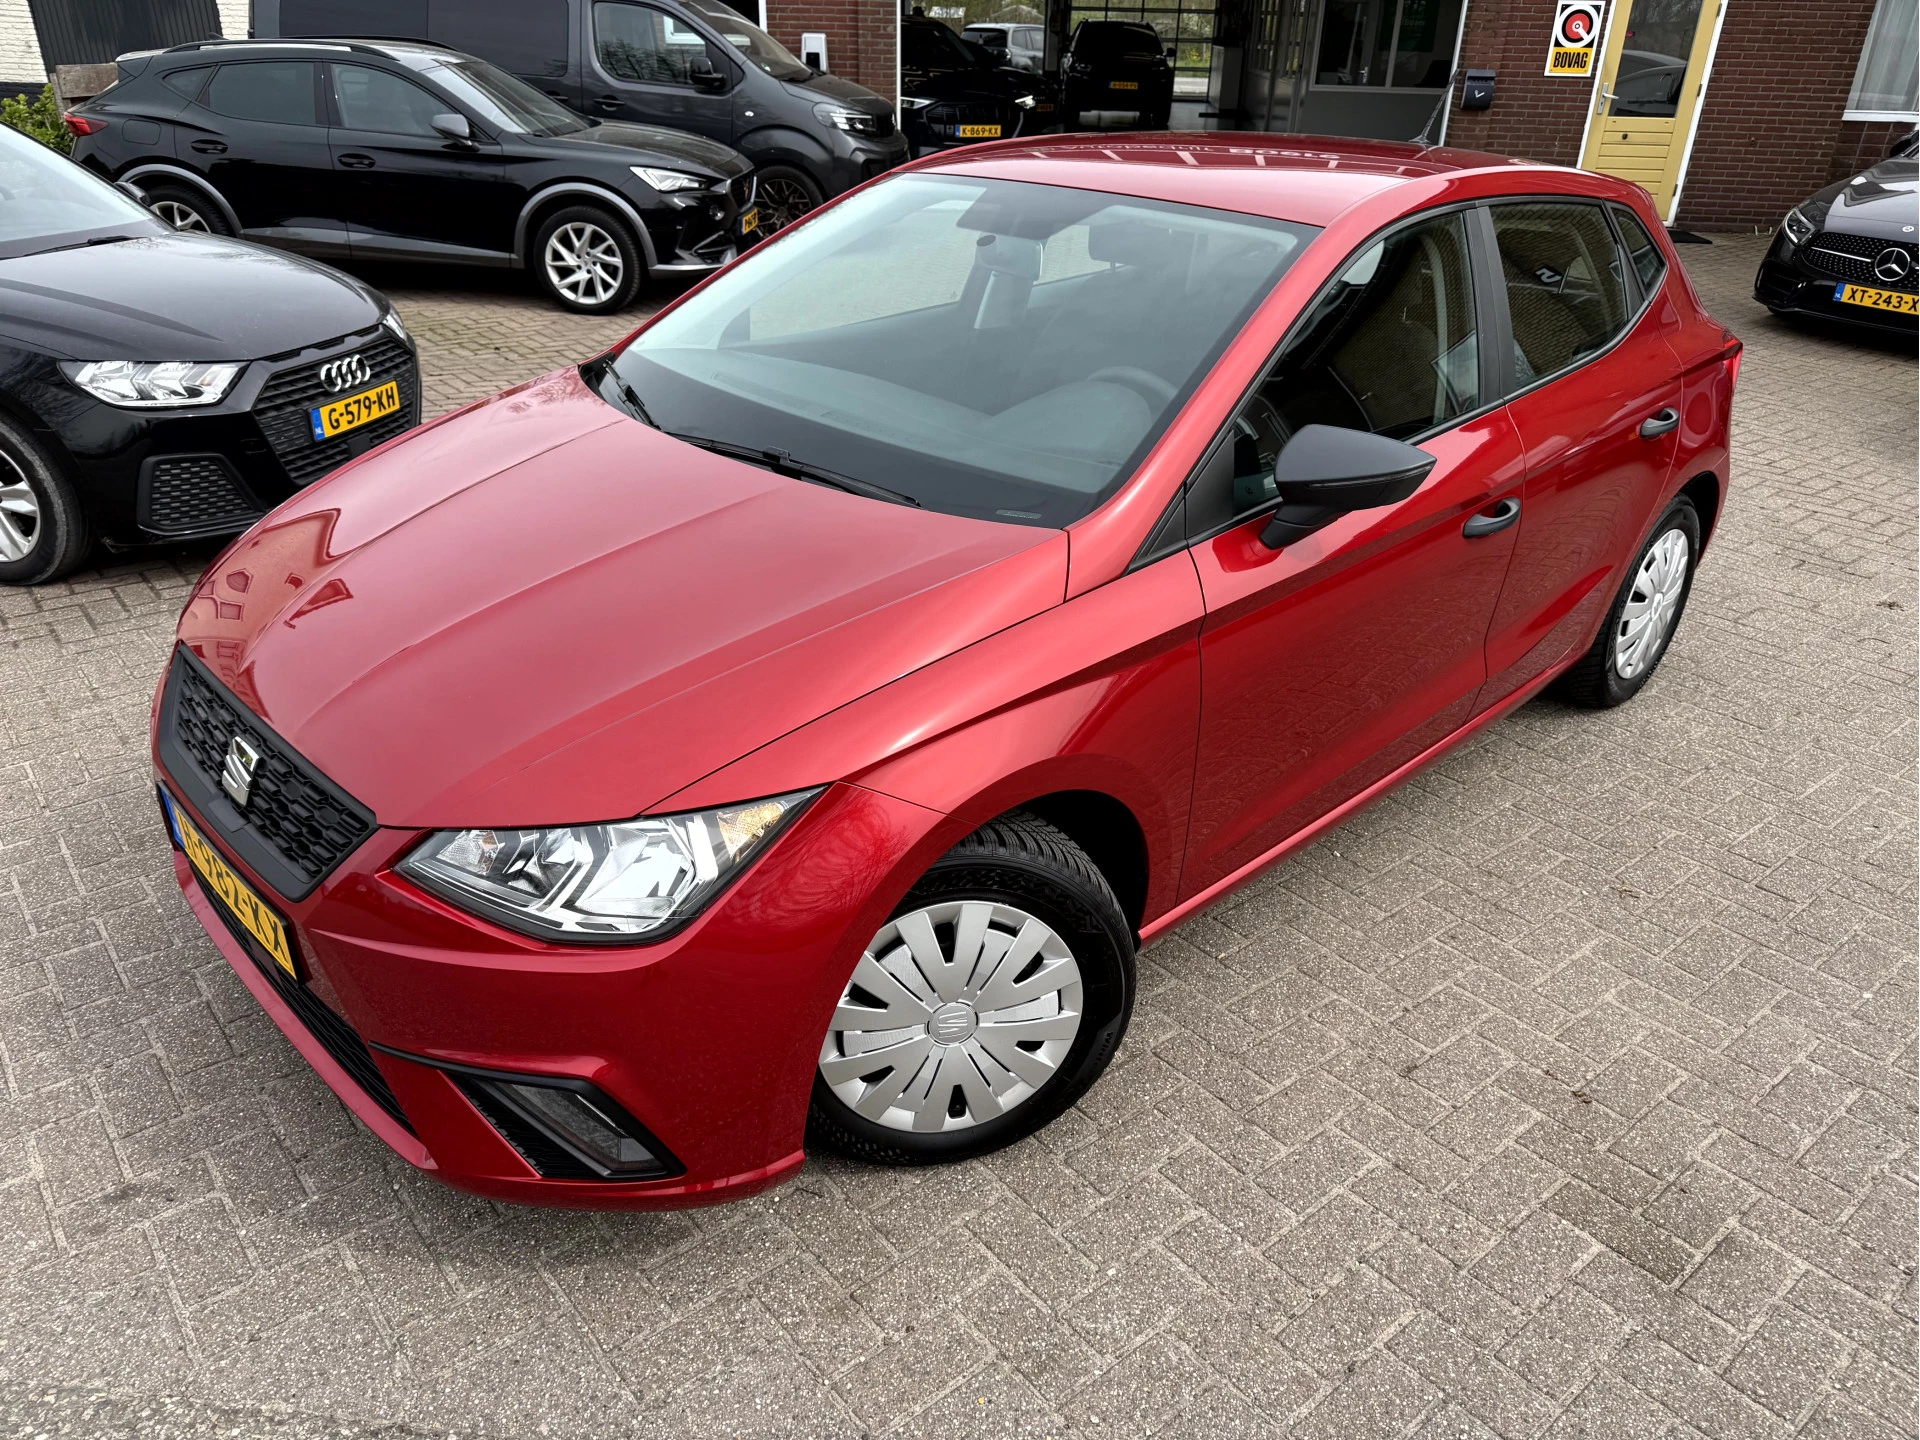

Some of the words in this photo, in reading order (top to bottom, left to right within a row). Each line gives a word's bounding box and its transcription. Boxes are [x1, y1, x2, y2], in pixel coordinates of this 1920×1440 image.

[1553, 52, 1588, 68] BOVAG
[962, 127, 998, 136] K-869-KX
[1848, 287, 1919, 312] XT-243-X
[328, 386, 395, 430] G-579-KH
[178, 811, 289, 963] H-982-KX
